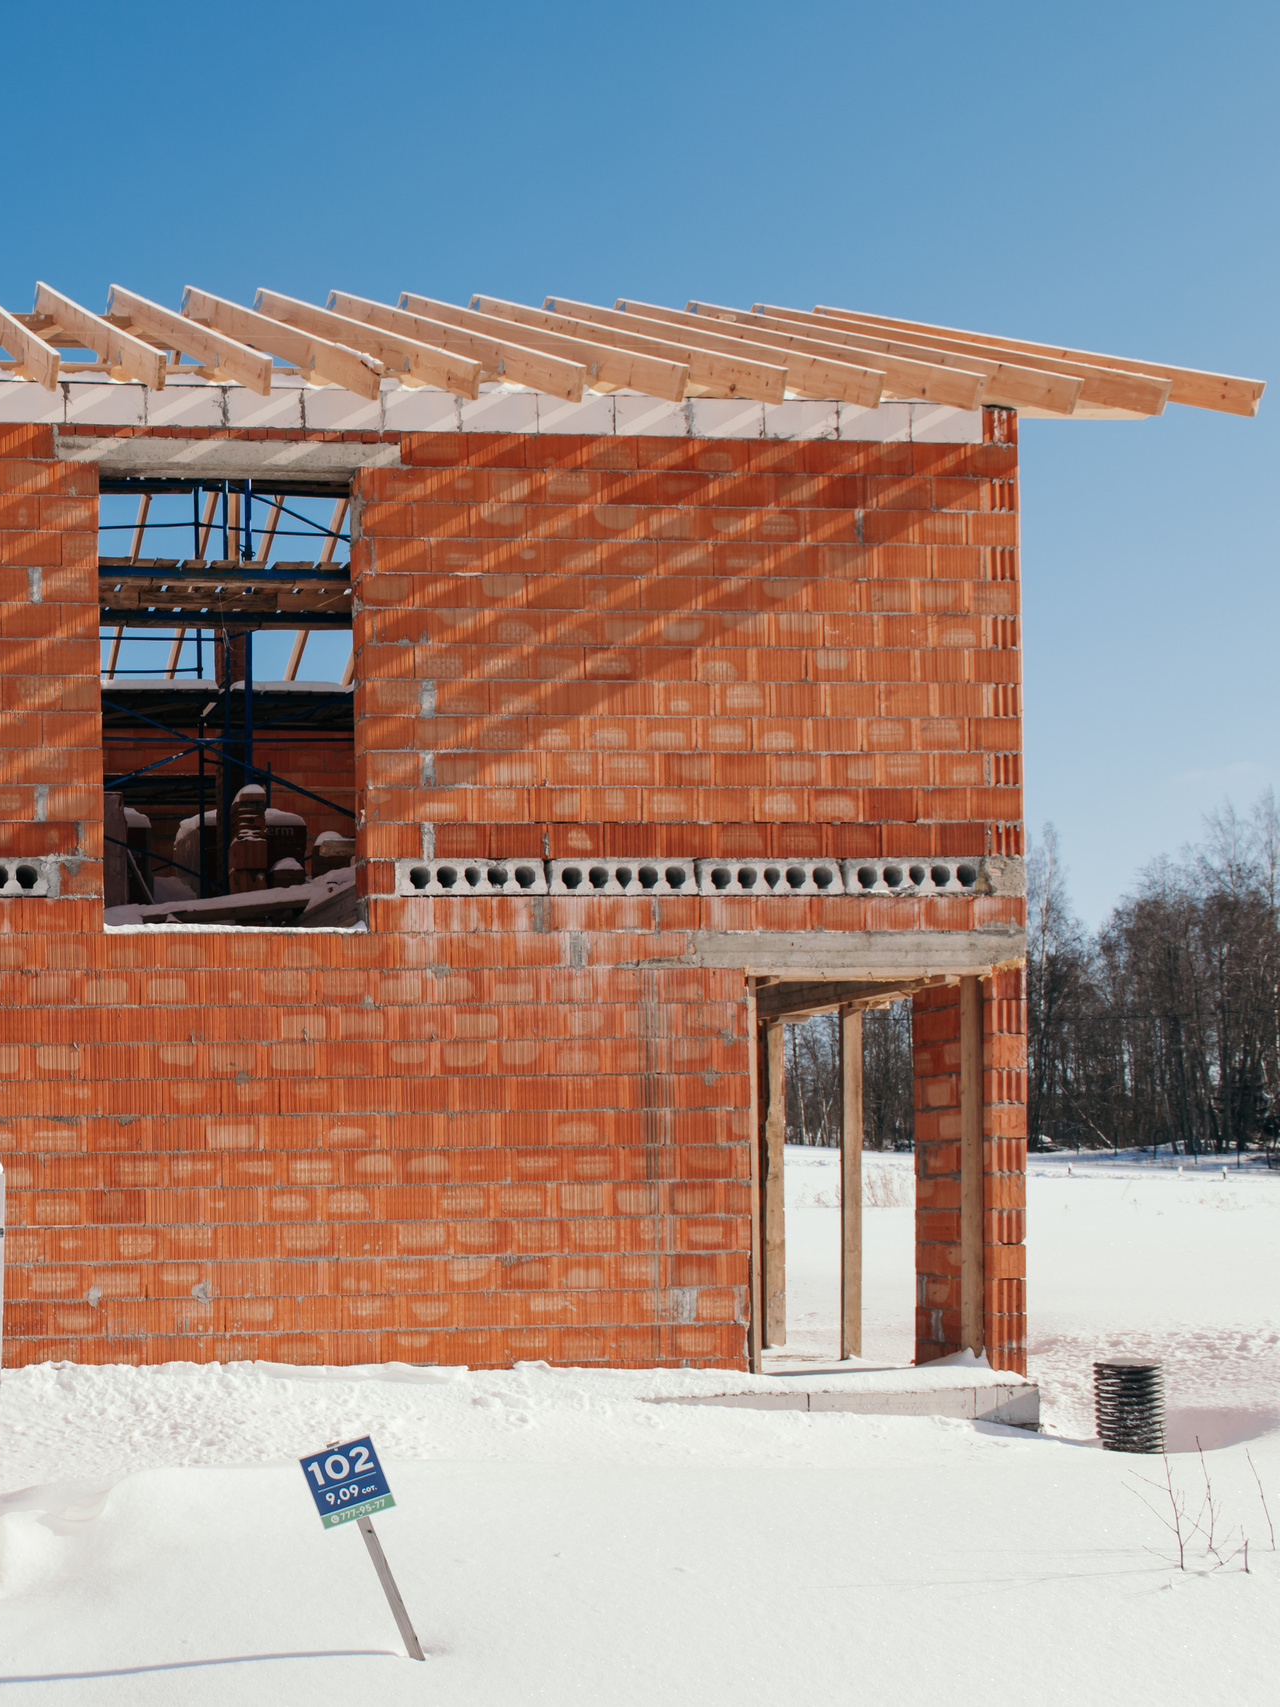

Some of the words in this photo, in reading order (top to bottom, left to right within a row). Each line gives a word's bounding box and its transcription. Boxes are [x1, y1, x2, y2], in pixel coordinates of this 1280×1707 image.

[308, 1446, 374, 1485] 102
[326, 1485, 358, 1505] 9,09
[362, 1485, 377, 1493] сот.
[340, 1499, 385, 1520] 777-95-77
